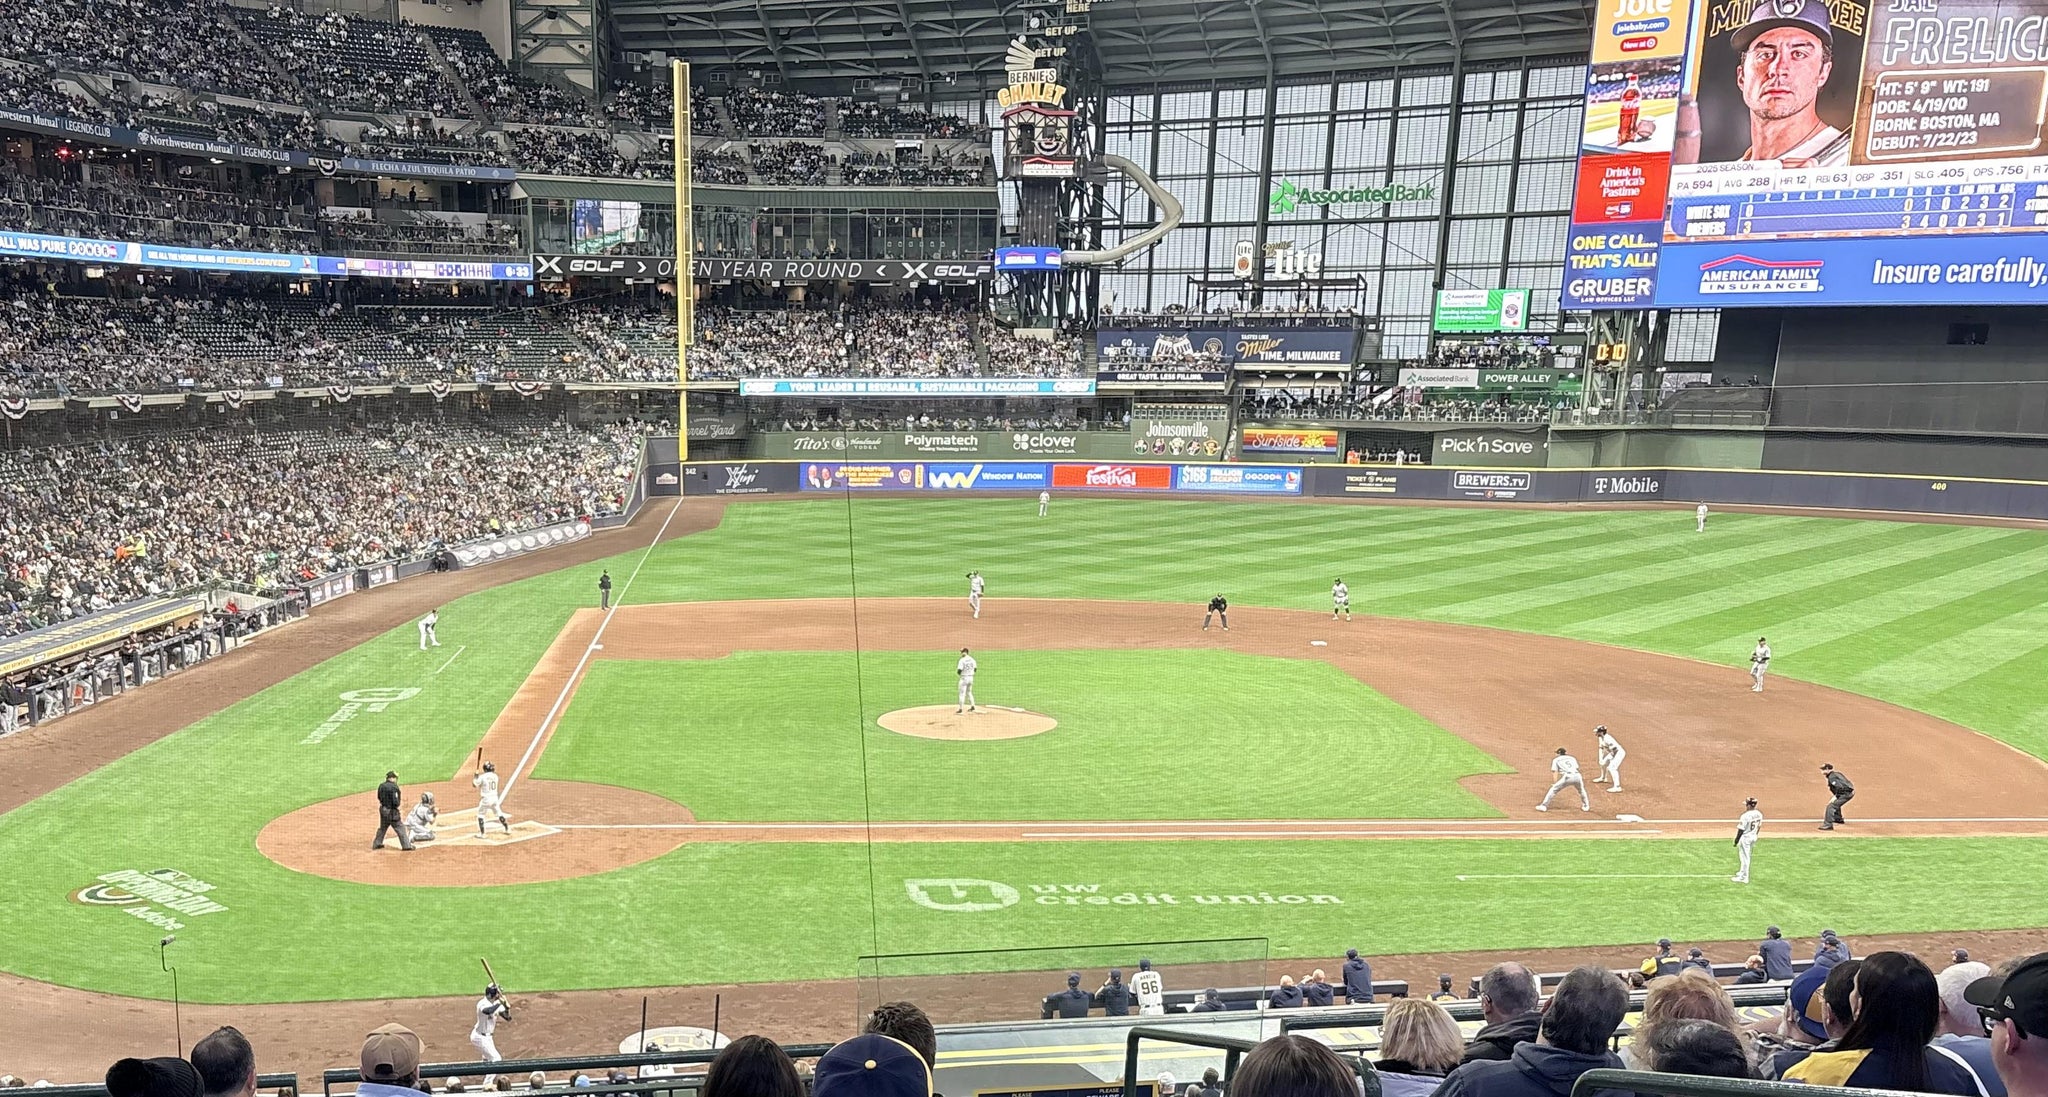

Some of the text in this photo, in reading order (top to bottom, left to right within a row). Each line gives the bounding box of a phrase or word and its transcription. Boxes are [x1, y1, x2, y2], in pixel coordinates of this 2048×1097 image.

[1066, 2, 1090, 13] HERE
[1045, 26, 1077, 36] GET UP
[1035, 47, 1066, 58] GET UP
[1010, 70, 1055, 83] BERNIE'S
[998, 83, 1067, 107] CHALET
[1879, 82, 1901, 96] HT:
[1943, 80, 1968, 93] WT:
[1970, 79, 1990, 92] 191
[1877, 97, 1968, 114] DOB: 4/19/00
[33, 114, 111, 137] Mutual LEGENDS CLUB
[1874, 113, 2000, 132] BORN: BOSTON, MA
[150, 134, 290, 161] Northwestern Mutual LEGENDS CLUB
[1872, 131, 1978, 150] DEBUT: 7/22/23
[372, 162, 476, 176] FLECHA AZUL TEQUILA PATIO
[1606, 166, 1642, 177] Drink in
[1697, 163, 1754, 173] 2025 SEASON
[1600, 177, 1645, 188] America's
[1677, 165, 2024, 190] PA 594 AVG .288 HR 12 RBI 63 OBP .351 SLG .405 OPS .756
[1602, 187, 1640, 197] Pastime
[1686, 194, 2009, 220] WHITE SOX 2 3 2
[1685, 213, 1986, 237] BREWERS 3 3 4 3
[19, 239, 109, 257] WAS PURE POWER
[1573, 236, 1606, 251] ONE
[536, 257, 563, 273] X
[570, 259, 625, 272] GOLF
[721, 261, 773, 277] YEAR
[784, 262, 863, 278] ROUND
[902, 262, 929, 279] X
[933, 265, 991, 277] GOLF
[1273, 249, 1323, 280] Lite
[1570, 252, 1657, 269] THAT'S ALL!
[1701, 267, 1821, 281] AMERICAN FAMILY
[1872, 257, 2047, 288] Insure carefully,
[1569, 277, 1652, 298] GRUBER
[1709, 282, 1808, 291] INSURANCE
[1121, 338, 1132, 347] GO
[1236, 338, 1284, 359] Miller
[1260, 350, 1341, 361] TIME, MILWAUKEE
[1597, 343, 1626, 360] 0:10
[1485, 374, 1519, 383] POWER
[1521, 374, 1551, 383] ALLEY
[790, 382, 1039, 393] YOUR LEADER IN REUSABLE, SUSTAINABLE PACKAGING
[710, 424, 736, 439] Yard
[1146, 420, 1209, 438] Johnsonville
[794, 437, 830, 450] Tito's
[904, 433, 1077, 448] Polymatech clover
[1252, 431, 1301, 449] Surfside
[1492, 440, 1533, 454] Save
[982, 472, 1043, 481] WINDOW NATION
[1086, 466, 1137, 486] festival
[1210, 468, 1243, 476] MILLION
[1458, 474, 1525, 487] BREWERS.TV
[1609, 477, 1659, 493] Mobile
[488, 781, 497, 791] 10
[1750, 819, 1760, 831] 67
[1034, 892, 1345, 905] credit union
[1141, 980, 1159, 995] 96
